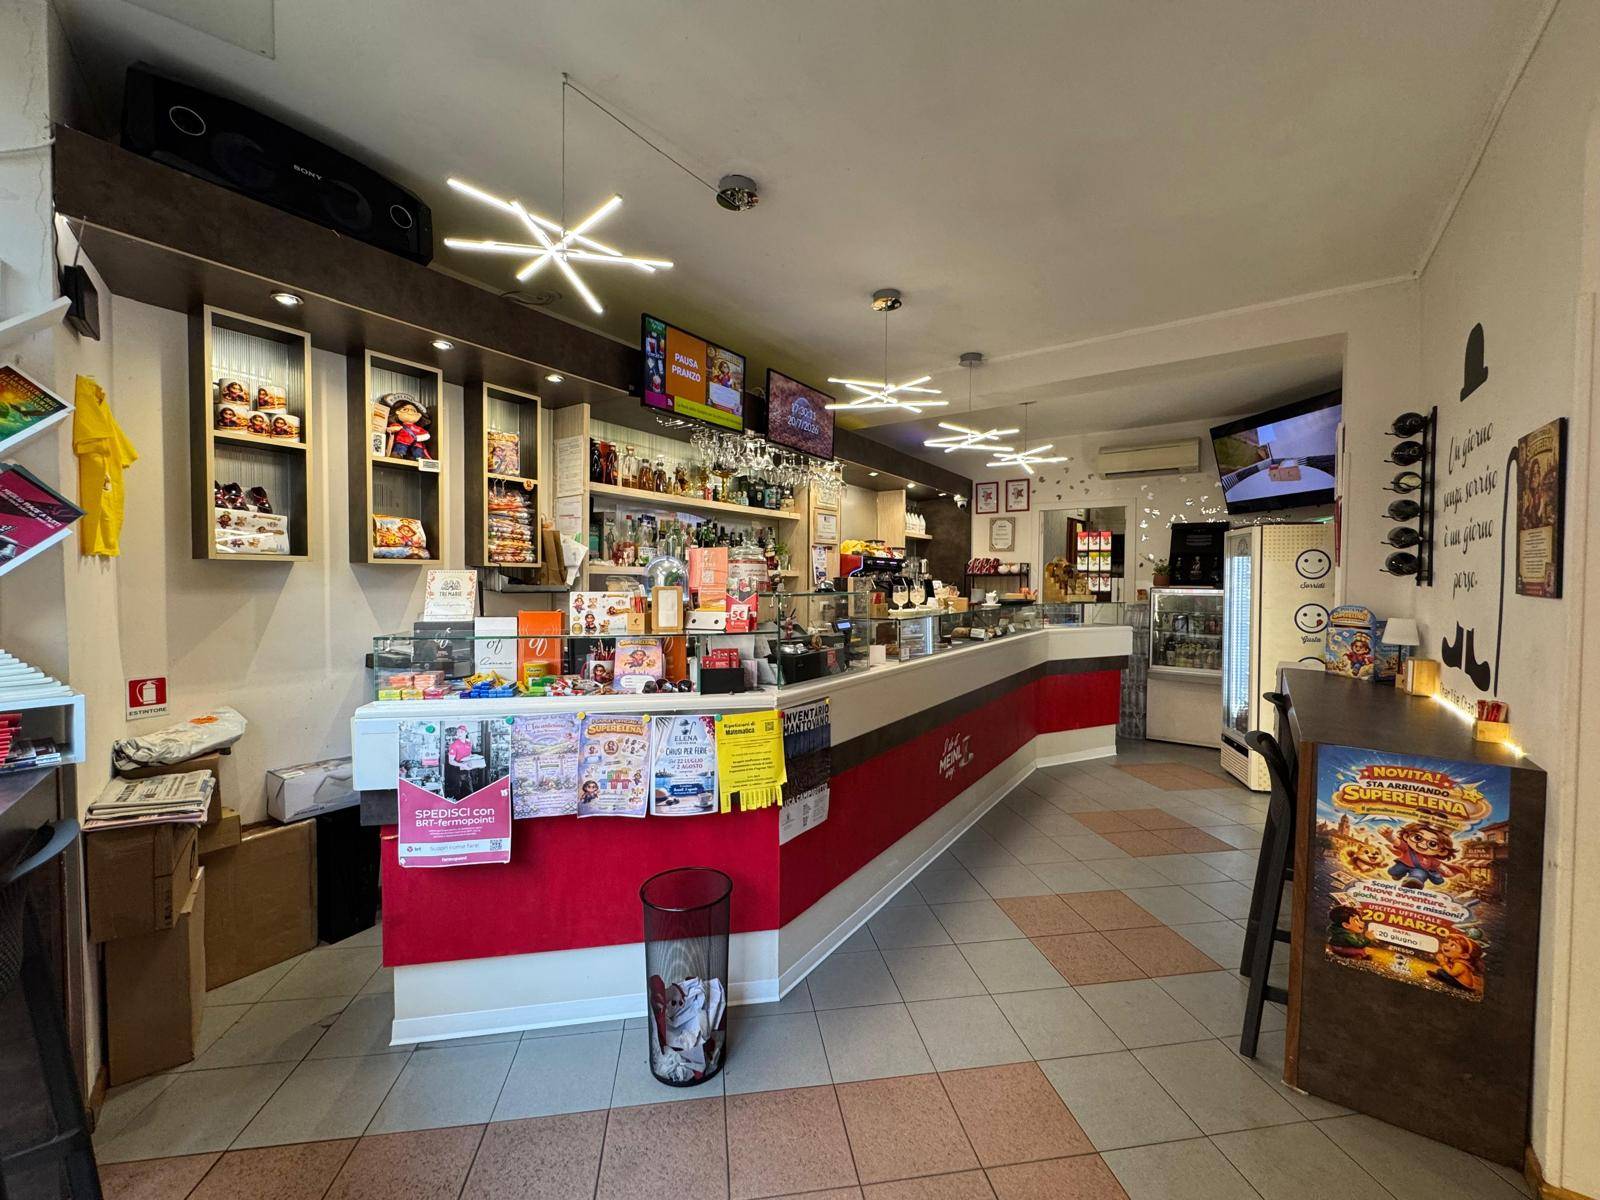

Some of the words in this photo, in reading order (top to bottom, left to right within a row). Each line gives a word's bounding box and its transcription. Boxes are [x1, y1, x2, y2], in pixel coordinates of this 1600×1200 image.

[292, 164, 323, 181] SONY
[674, 353, 699, 369] PAUSA
[672, 365, 701, 382] PRANZO
[1449, 435, 1461, 475] Un
[1462, 422, 1494, 468] giorno
[1443, 486, 1463, 514] senza
[1464, 465, 1498, 504] sorriso
[1450, 529, 1461, 546] un
[1462, 518, 1494, 555] giorno
[129, 707, 167, 716] ESTINTORE
[784, 703, 830, 725] INVENTARIO
[725, 727, 755, 736] Matematica
[783, 714, 829, 736] MANTOVANO
[665, 747, 683, 756] CHIUSI
[683, 747, 694, 755] PER
[694, 746, 708, 755] FERIE
[1366, 780, 1384, 788] STA
[1386, 781, 1450, 798] ARRIVANDO
[415, 807, 470, 819] SPEDISCI
[473, 807, 495, 816] con
[1363, 885, 1393, 896] nuove
[1371, 880, 1396, 890] Scopri
[1398, 886, 1416, 895] ogni
[1416, 890, 1438, 898] mese
[1353, 891, 1379, 902] giochi,
[1380, 896, 1415, 908] sorprese
[1423, 905, 1465, 920] missioni!
[1368, 904, 1396, 914] USCITA
[1398, 909, 1442, 924] UFFICIALE
[1362, 909, 1386, 922] 20
[1388, 914, 1450, 938] MARZO
[1378, 930, 1389, 938] 20
[1390, 933, 1418, 946] giugno
